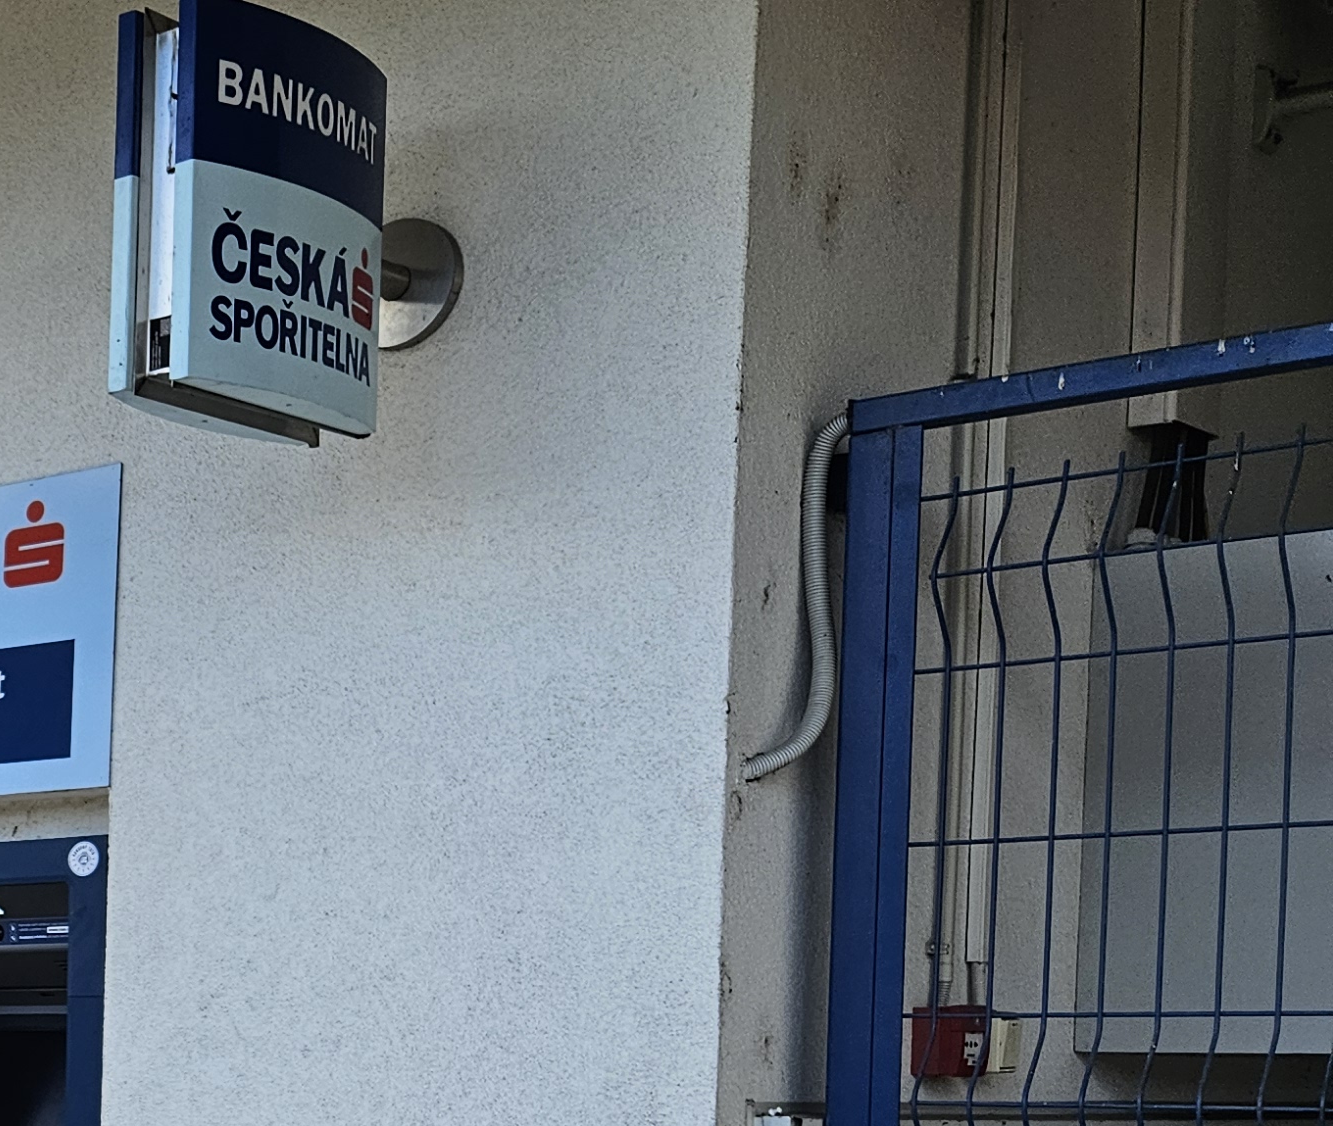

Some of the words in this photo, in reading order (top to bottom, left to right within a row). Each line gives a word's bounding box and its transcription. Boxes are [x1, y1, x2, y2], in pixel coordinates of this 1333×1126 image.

[218, 59, 377, 165] BANKOMAT
[211, 207, 350, 319] ČESKÁ
[209, 295, 370, 387] SPOŘITELNA
